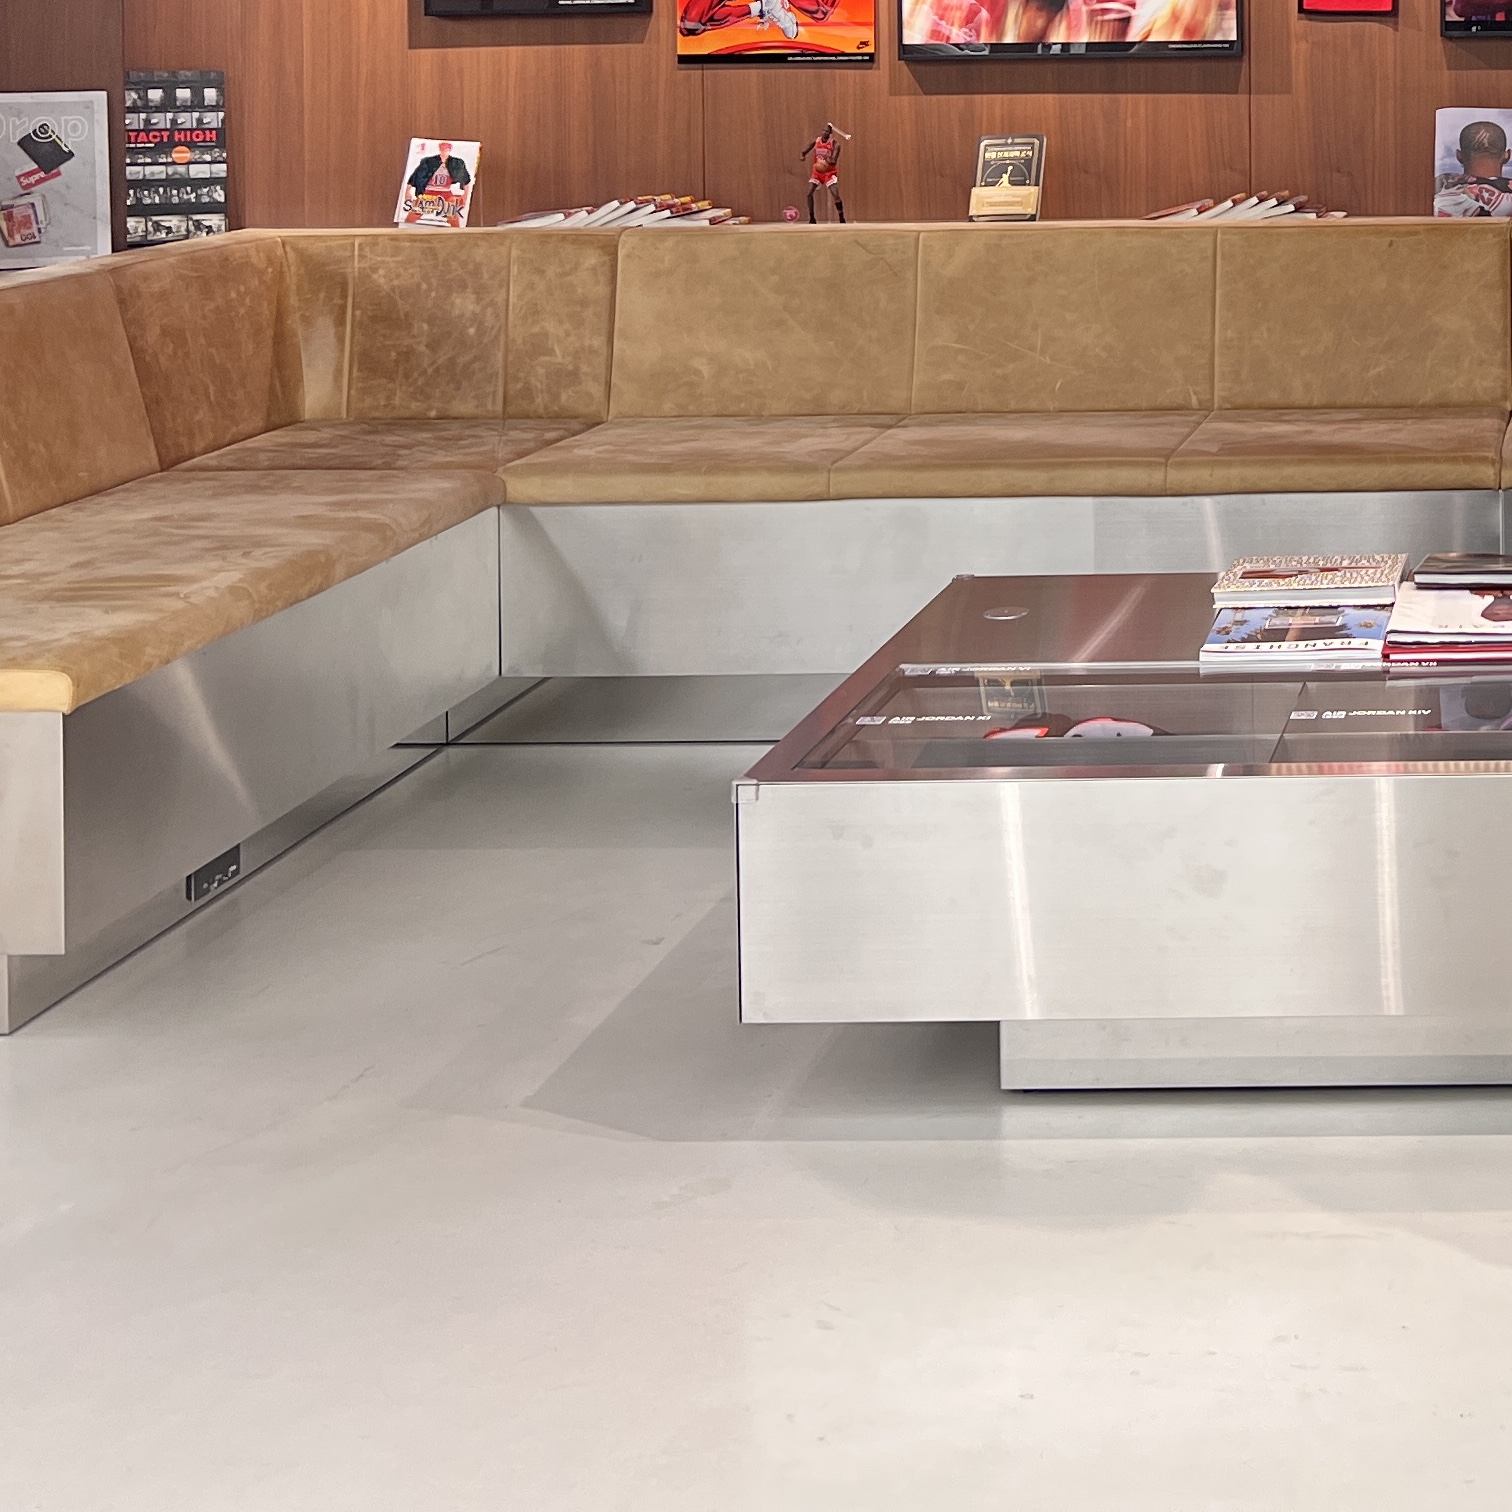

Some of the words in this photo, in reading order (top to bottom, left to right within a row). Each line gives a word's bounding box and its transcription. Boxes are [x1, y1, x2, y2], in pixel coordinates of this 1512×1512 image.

[127, 130, 170, 144] TACT
[173, 129, 217, 143] HIGH
[1219, 639, 1371, 651] FRANCHISE
